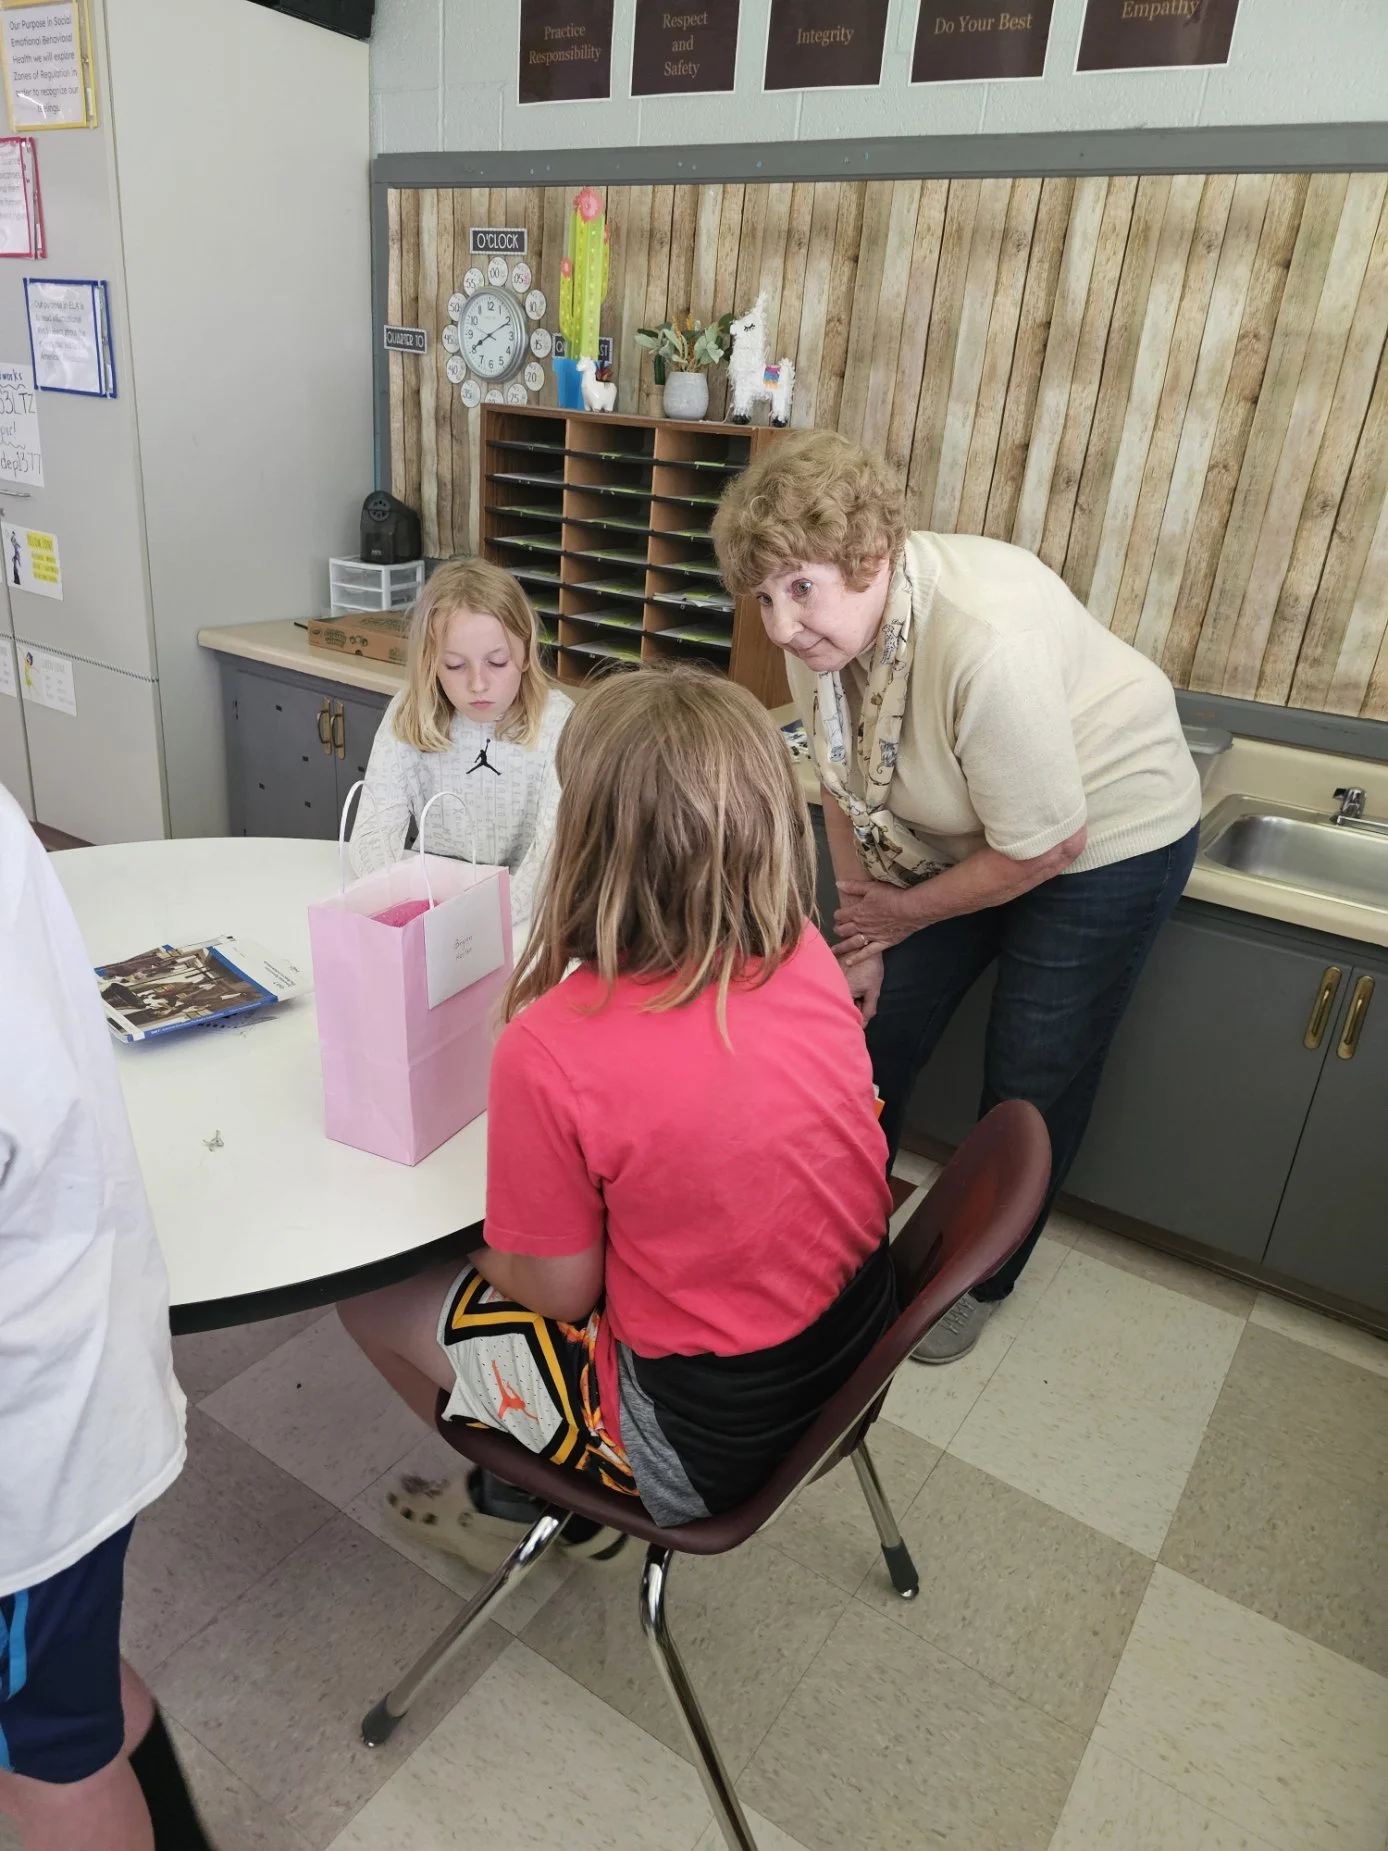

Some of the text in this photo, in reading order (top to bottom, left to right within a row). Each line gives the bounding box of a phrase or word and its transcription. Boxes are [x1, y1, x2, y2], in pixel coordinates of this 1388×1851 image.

[1121, 0, 1200, 20] Empathy
[9, 15, 71, 31] Our Purpose in Social
[662, 11, 708, 30] Respect
[934, 12, 1033, 34] Do Your Best
[544, 23, 586, 40] Practice
[796, 25, 854, 47] Integrity
[11, 36, 41, 47] Emotional
[672, 35, 694, 52] and
[12, 54, 32, 63] Health
[54, 51, 75, 63] explore
[529, 44, 601, 66] Responsibility
[664, 59, 700, 79] Safety
[13, 71, 32, 81] Zones
[477, 233, 519, 249] O'CLOCK
[487, 301, 495, 312] 12
[471, 315, 479, 326] 10
[467, 329, 474, 339] 9
[508, 331, 515, 342] 3
[505, 345, 511, 356] 4
[480, 355, 485, 366] 7
[488, 360, 494, 370] 6
[498, 355, 505, 366] 5
